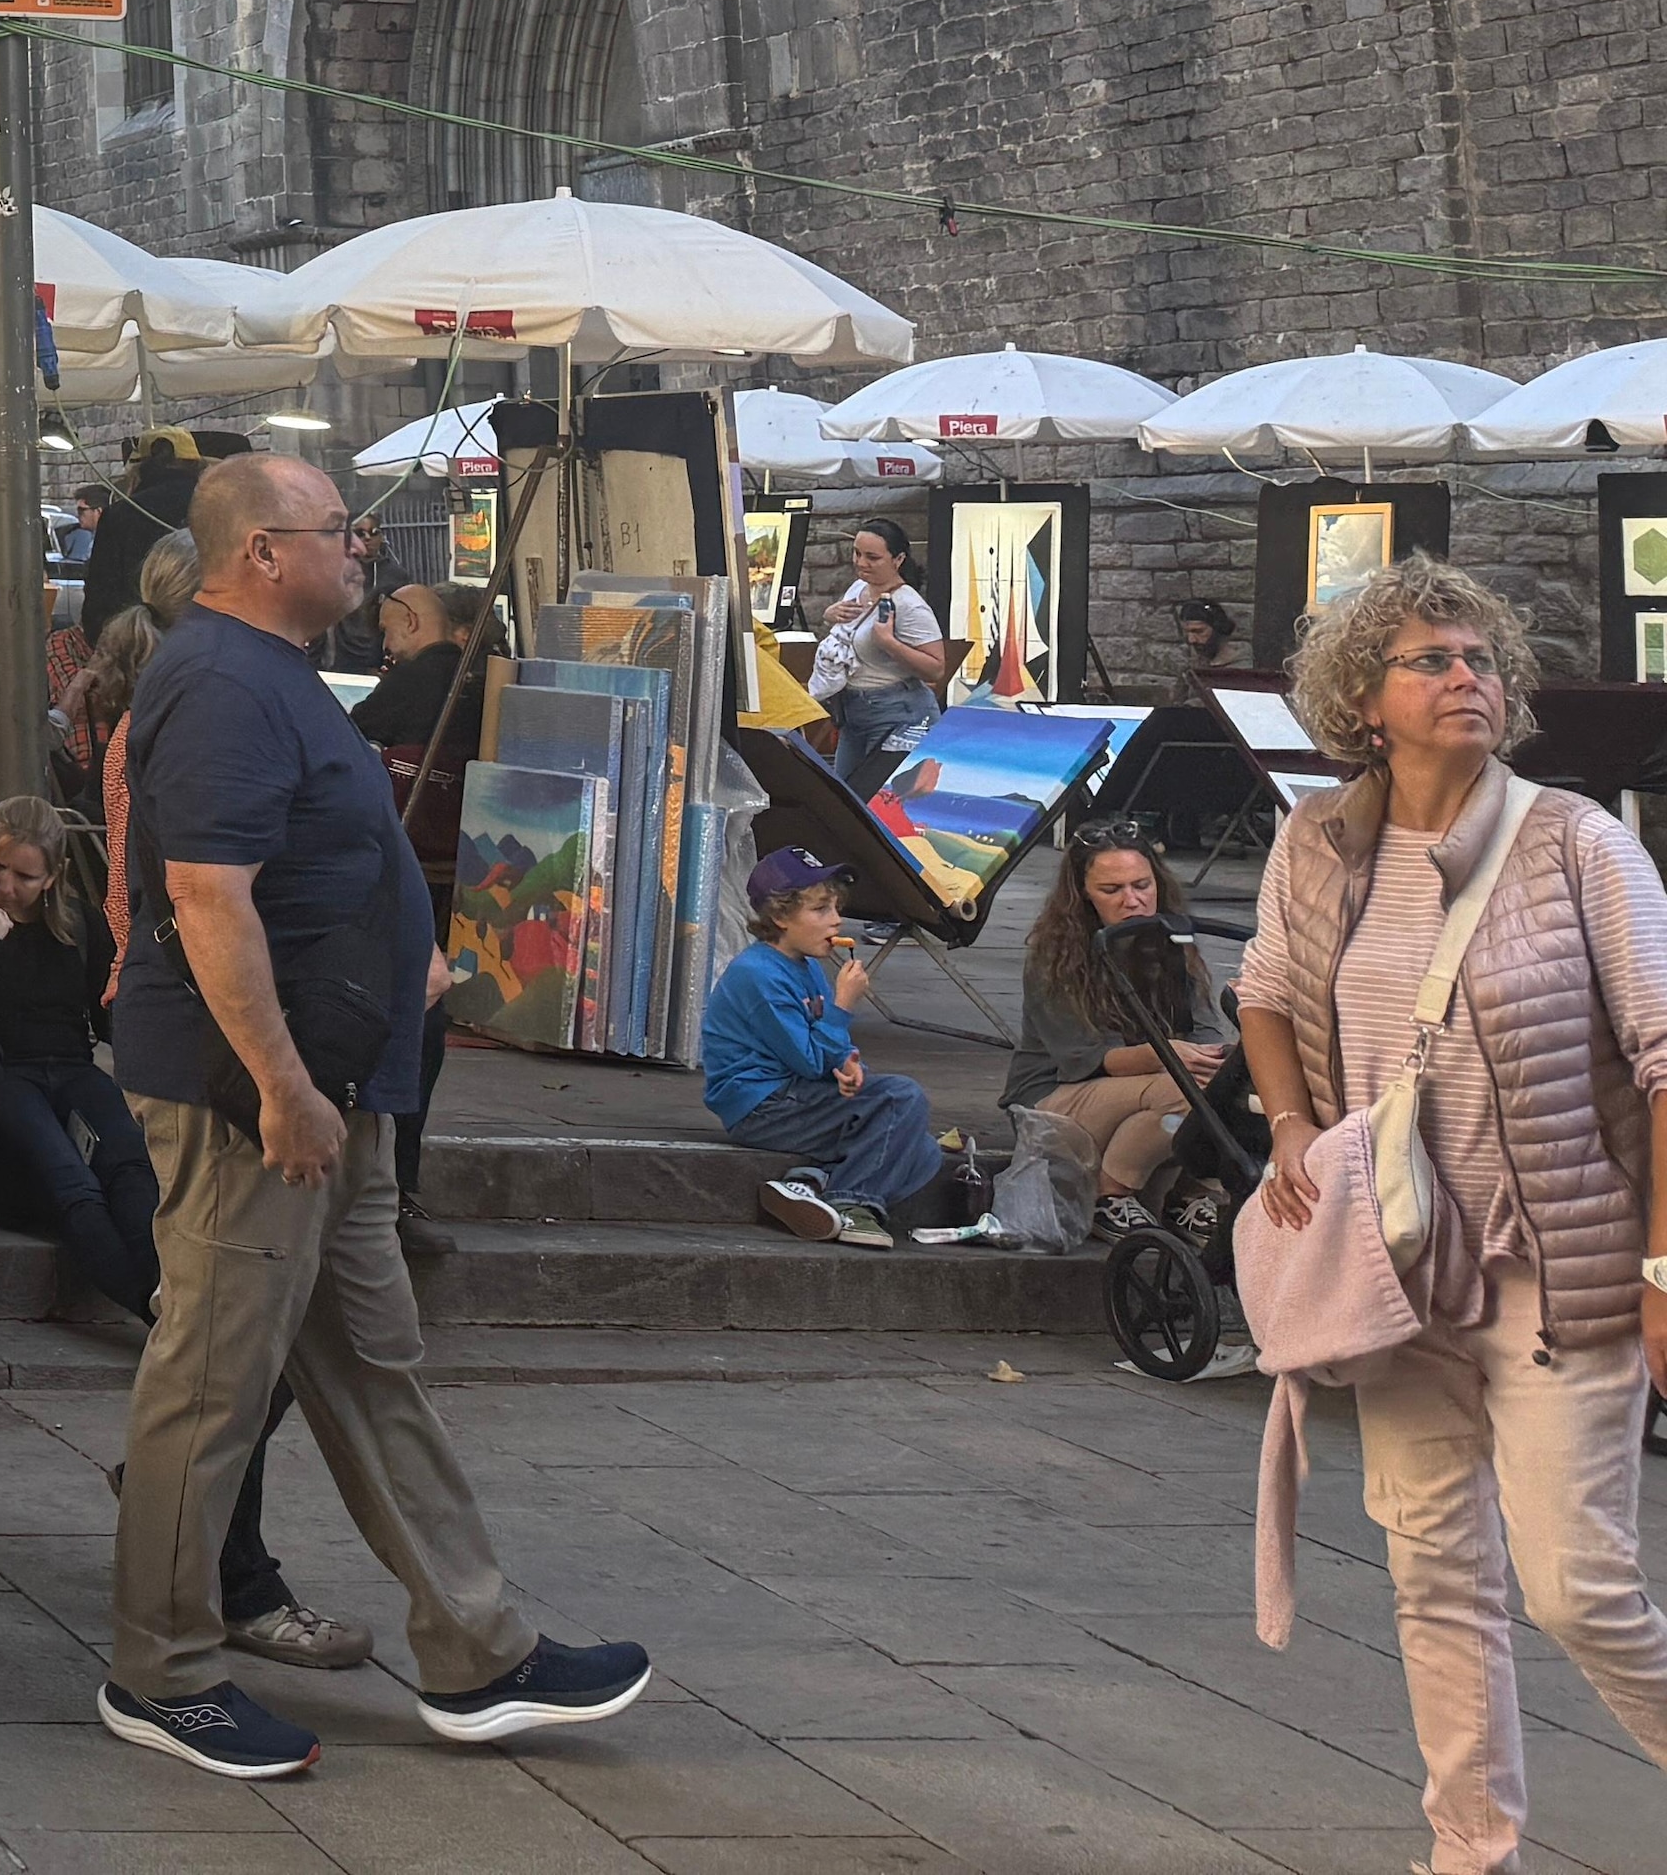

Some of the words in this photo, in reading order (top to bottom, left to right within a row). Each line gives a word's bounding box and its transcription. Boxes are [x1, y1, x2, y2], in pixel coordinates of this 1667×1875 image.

[949, 420, 988, 434] Piera
[461, 461, 493, 473] Piera
[884, 461, 910, 474] Piera
